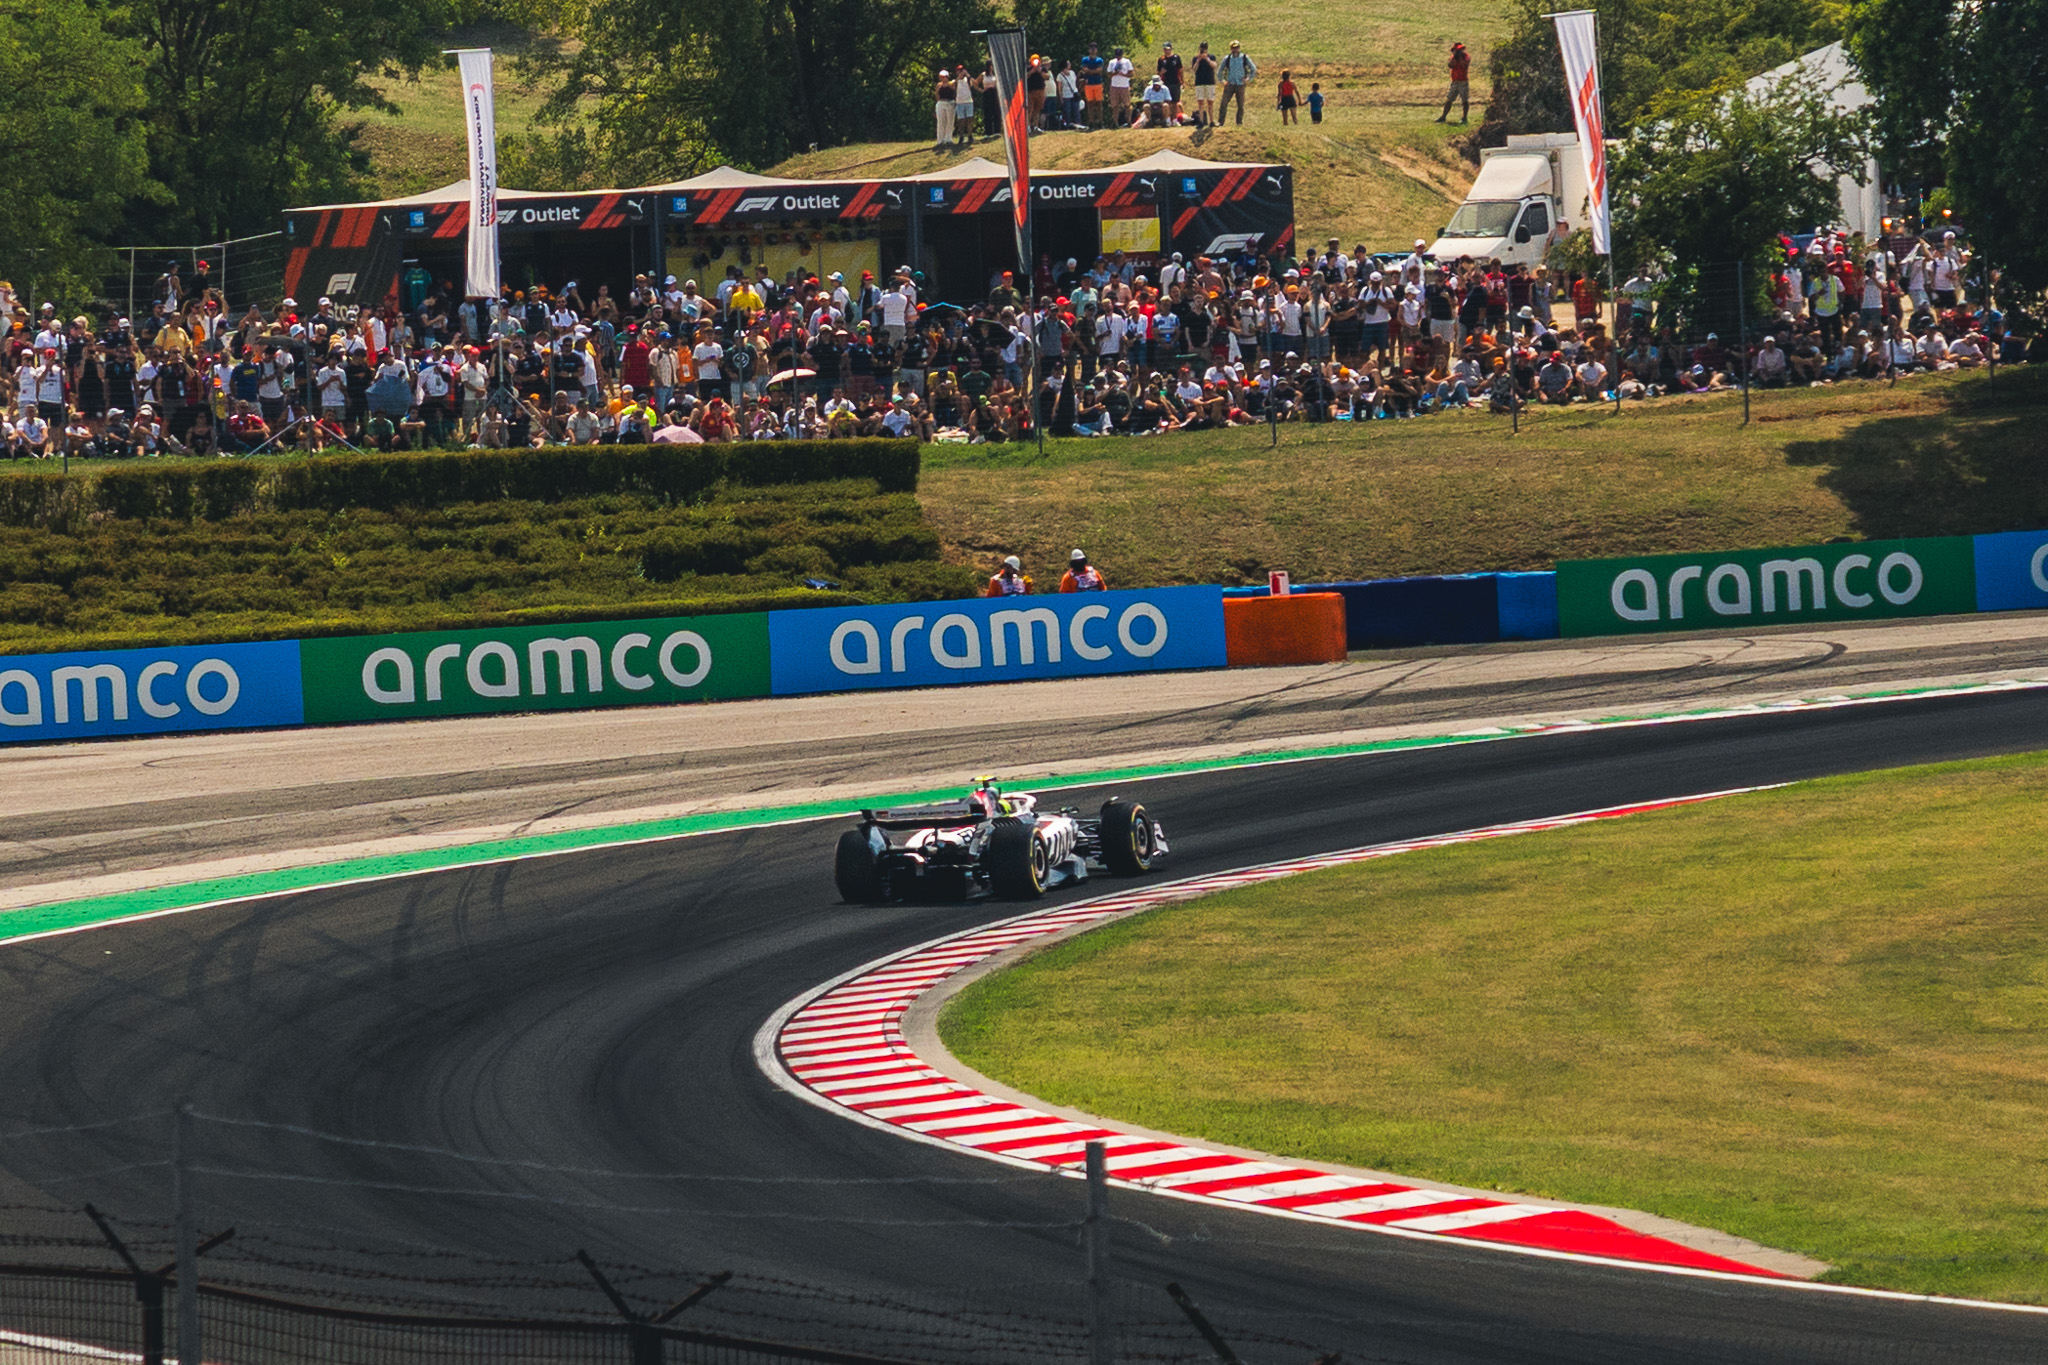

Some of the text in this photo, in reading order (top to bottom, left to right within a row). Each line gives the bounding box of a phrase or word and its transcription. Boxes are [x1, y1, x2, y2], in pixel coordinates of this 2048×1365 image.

[783, 194, 840, 210] Outlet
[1039, 184, 1095, 199] Outlet
[522, 206, 580, 223] Outlet
[1611, 552, 1924, 621] aramco
[829, 602, 1167, 674] aramco
[361, 630, 713, 704] aramco
